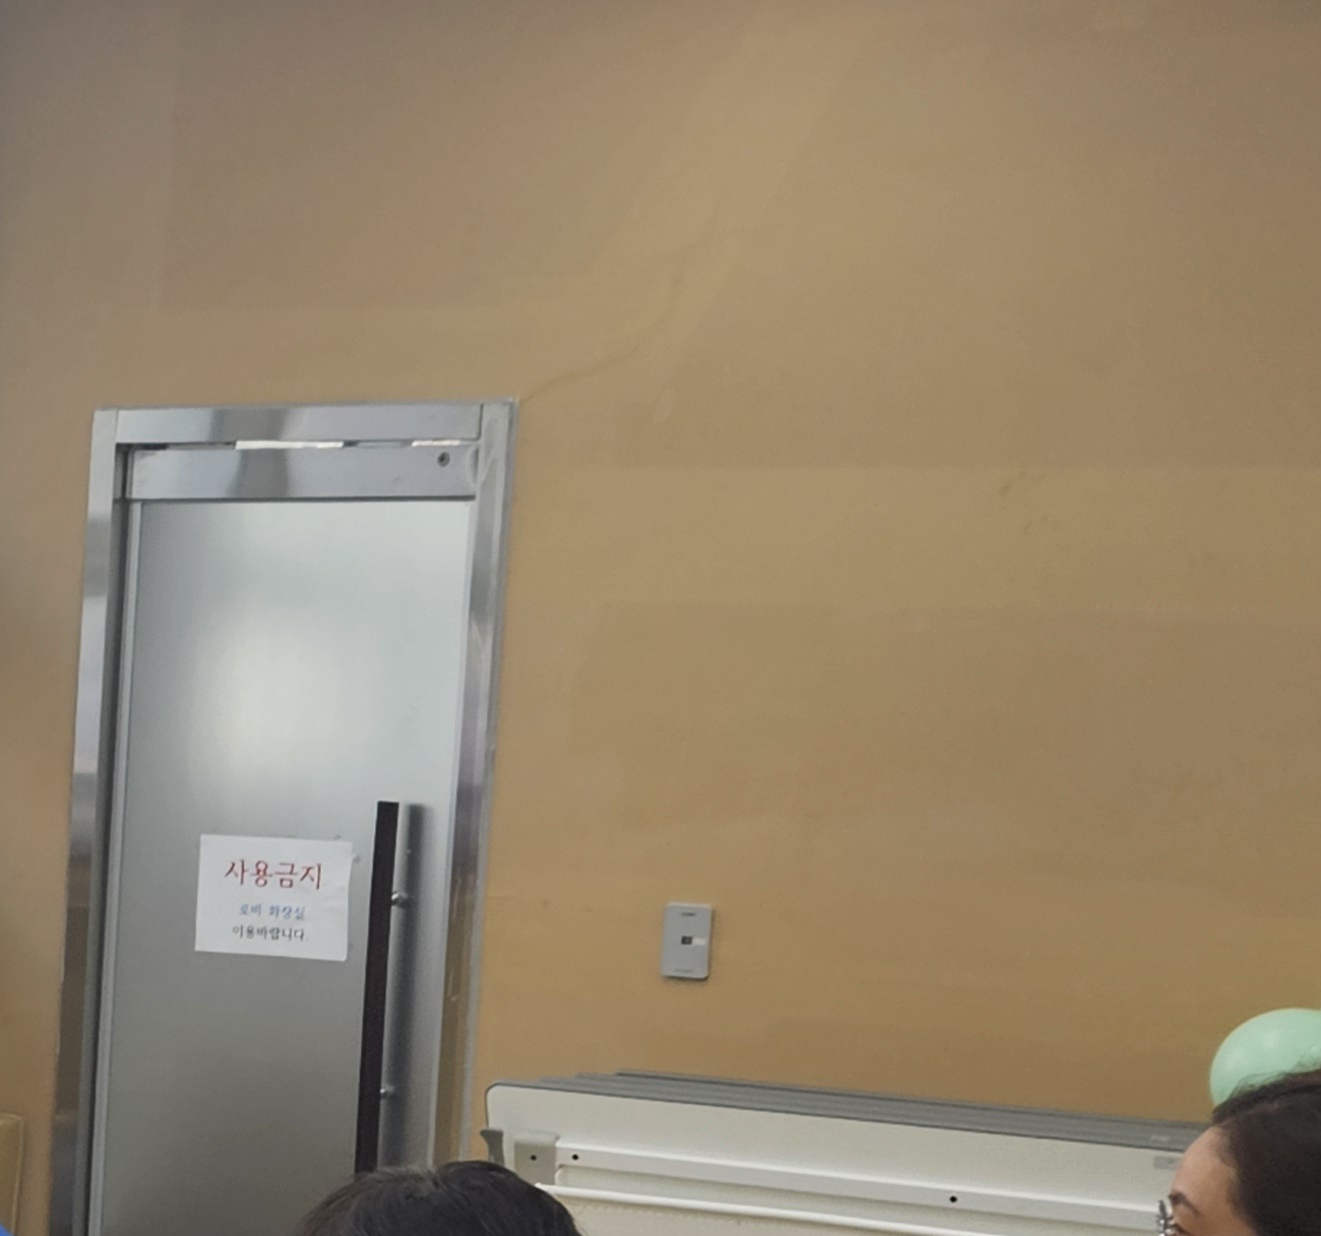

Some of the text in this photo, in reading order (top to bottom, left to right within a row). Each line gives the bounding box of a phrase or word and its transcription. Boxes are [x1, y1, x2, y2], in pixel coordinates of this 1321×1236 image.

[224, 858, 322, 890] 사용금지
[239, 903, 306, 921] 로비 화장실
[231, 923, 305, 942] 이용바랍니다
